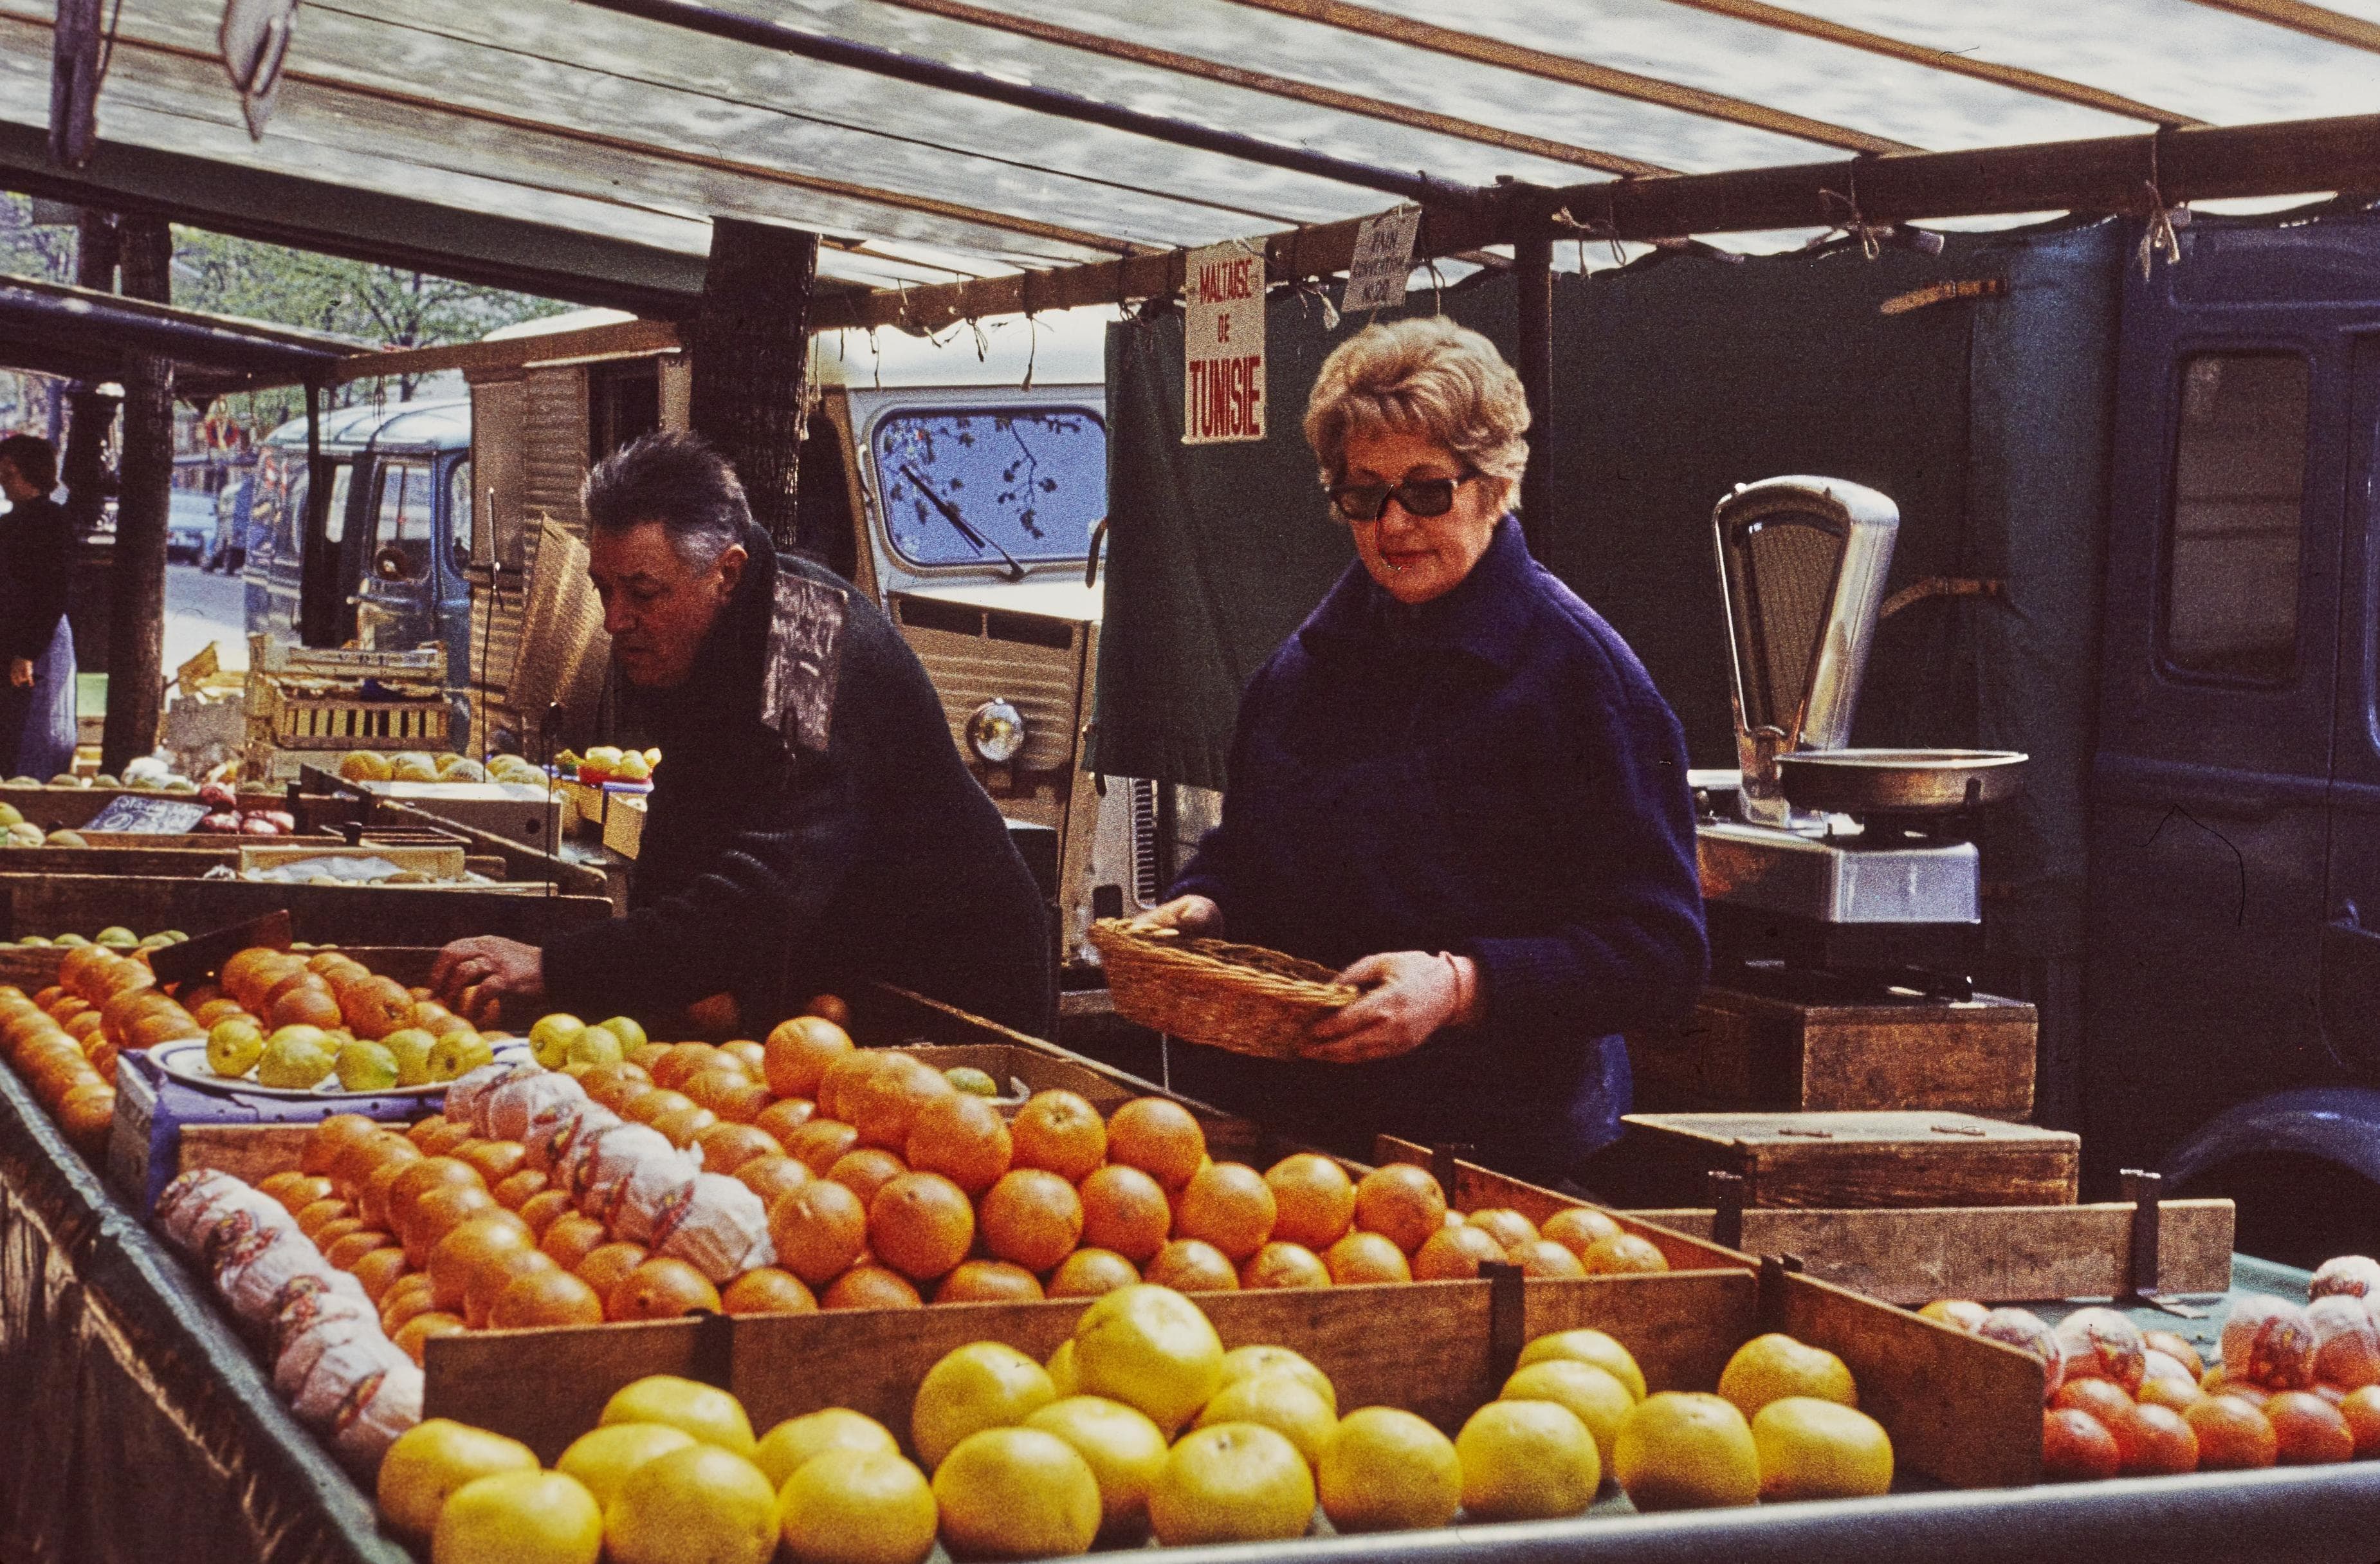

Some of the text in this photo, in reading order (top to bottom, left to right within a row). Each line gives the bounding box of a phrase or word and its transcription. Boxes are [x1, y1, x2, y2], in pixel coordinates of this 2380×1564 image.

[1200, 259, 1252, 303] MALTAISE
[1218, 313, 1230, 342] DE
[1190, 355, 1261, 437] TUNISIE
